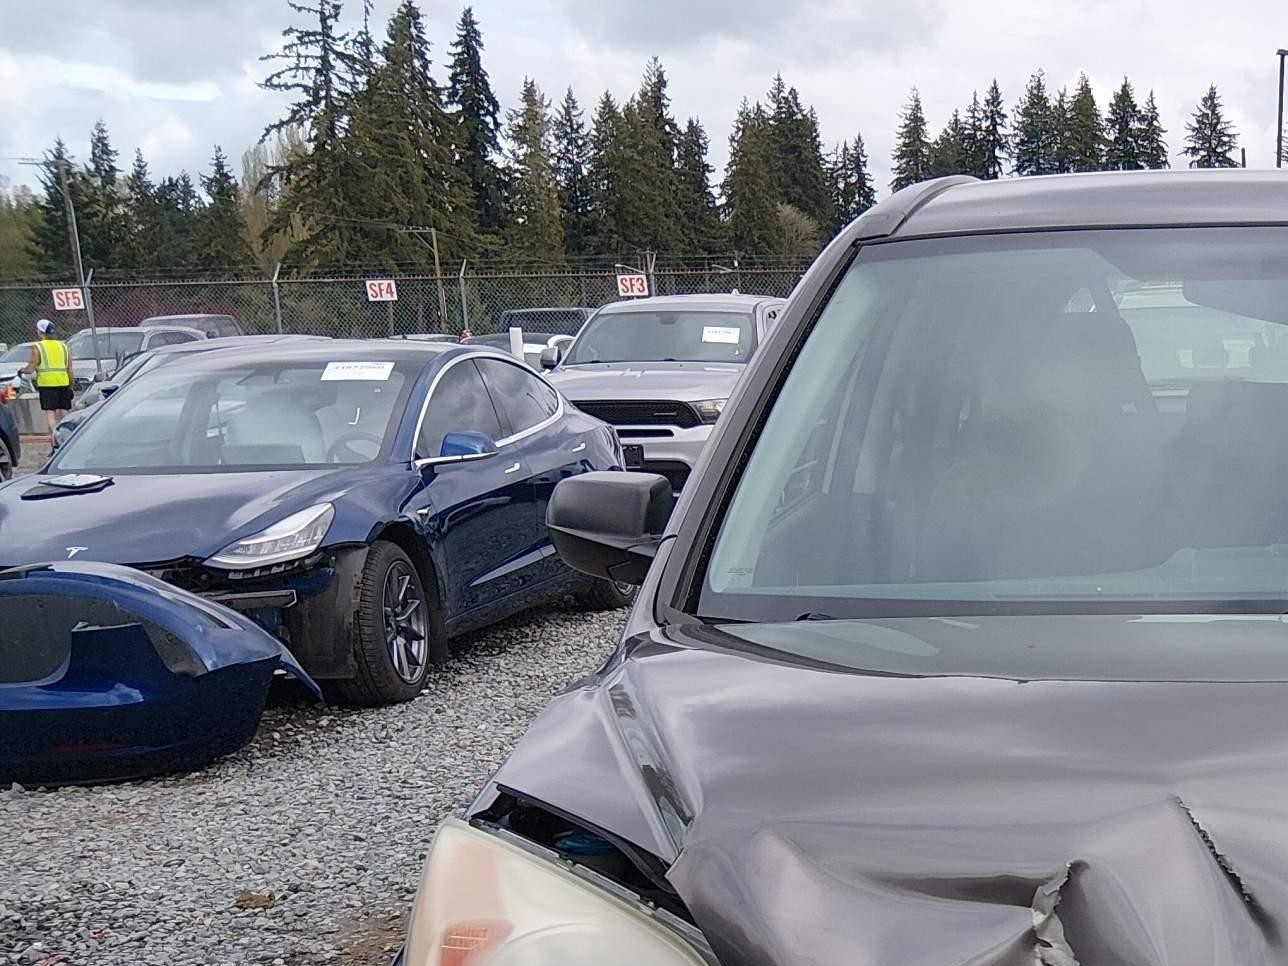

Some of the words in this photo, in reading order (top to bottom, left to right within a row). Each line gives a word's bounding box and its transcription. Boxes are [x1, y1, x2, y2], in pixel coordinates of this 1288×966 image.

[368, 282, 395, 299] SF4
[620, 277, 646, 294] SF3
[55, 291, 81, 307] SF5
